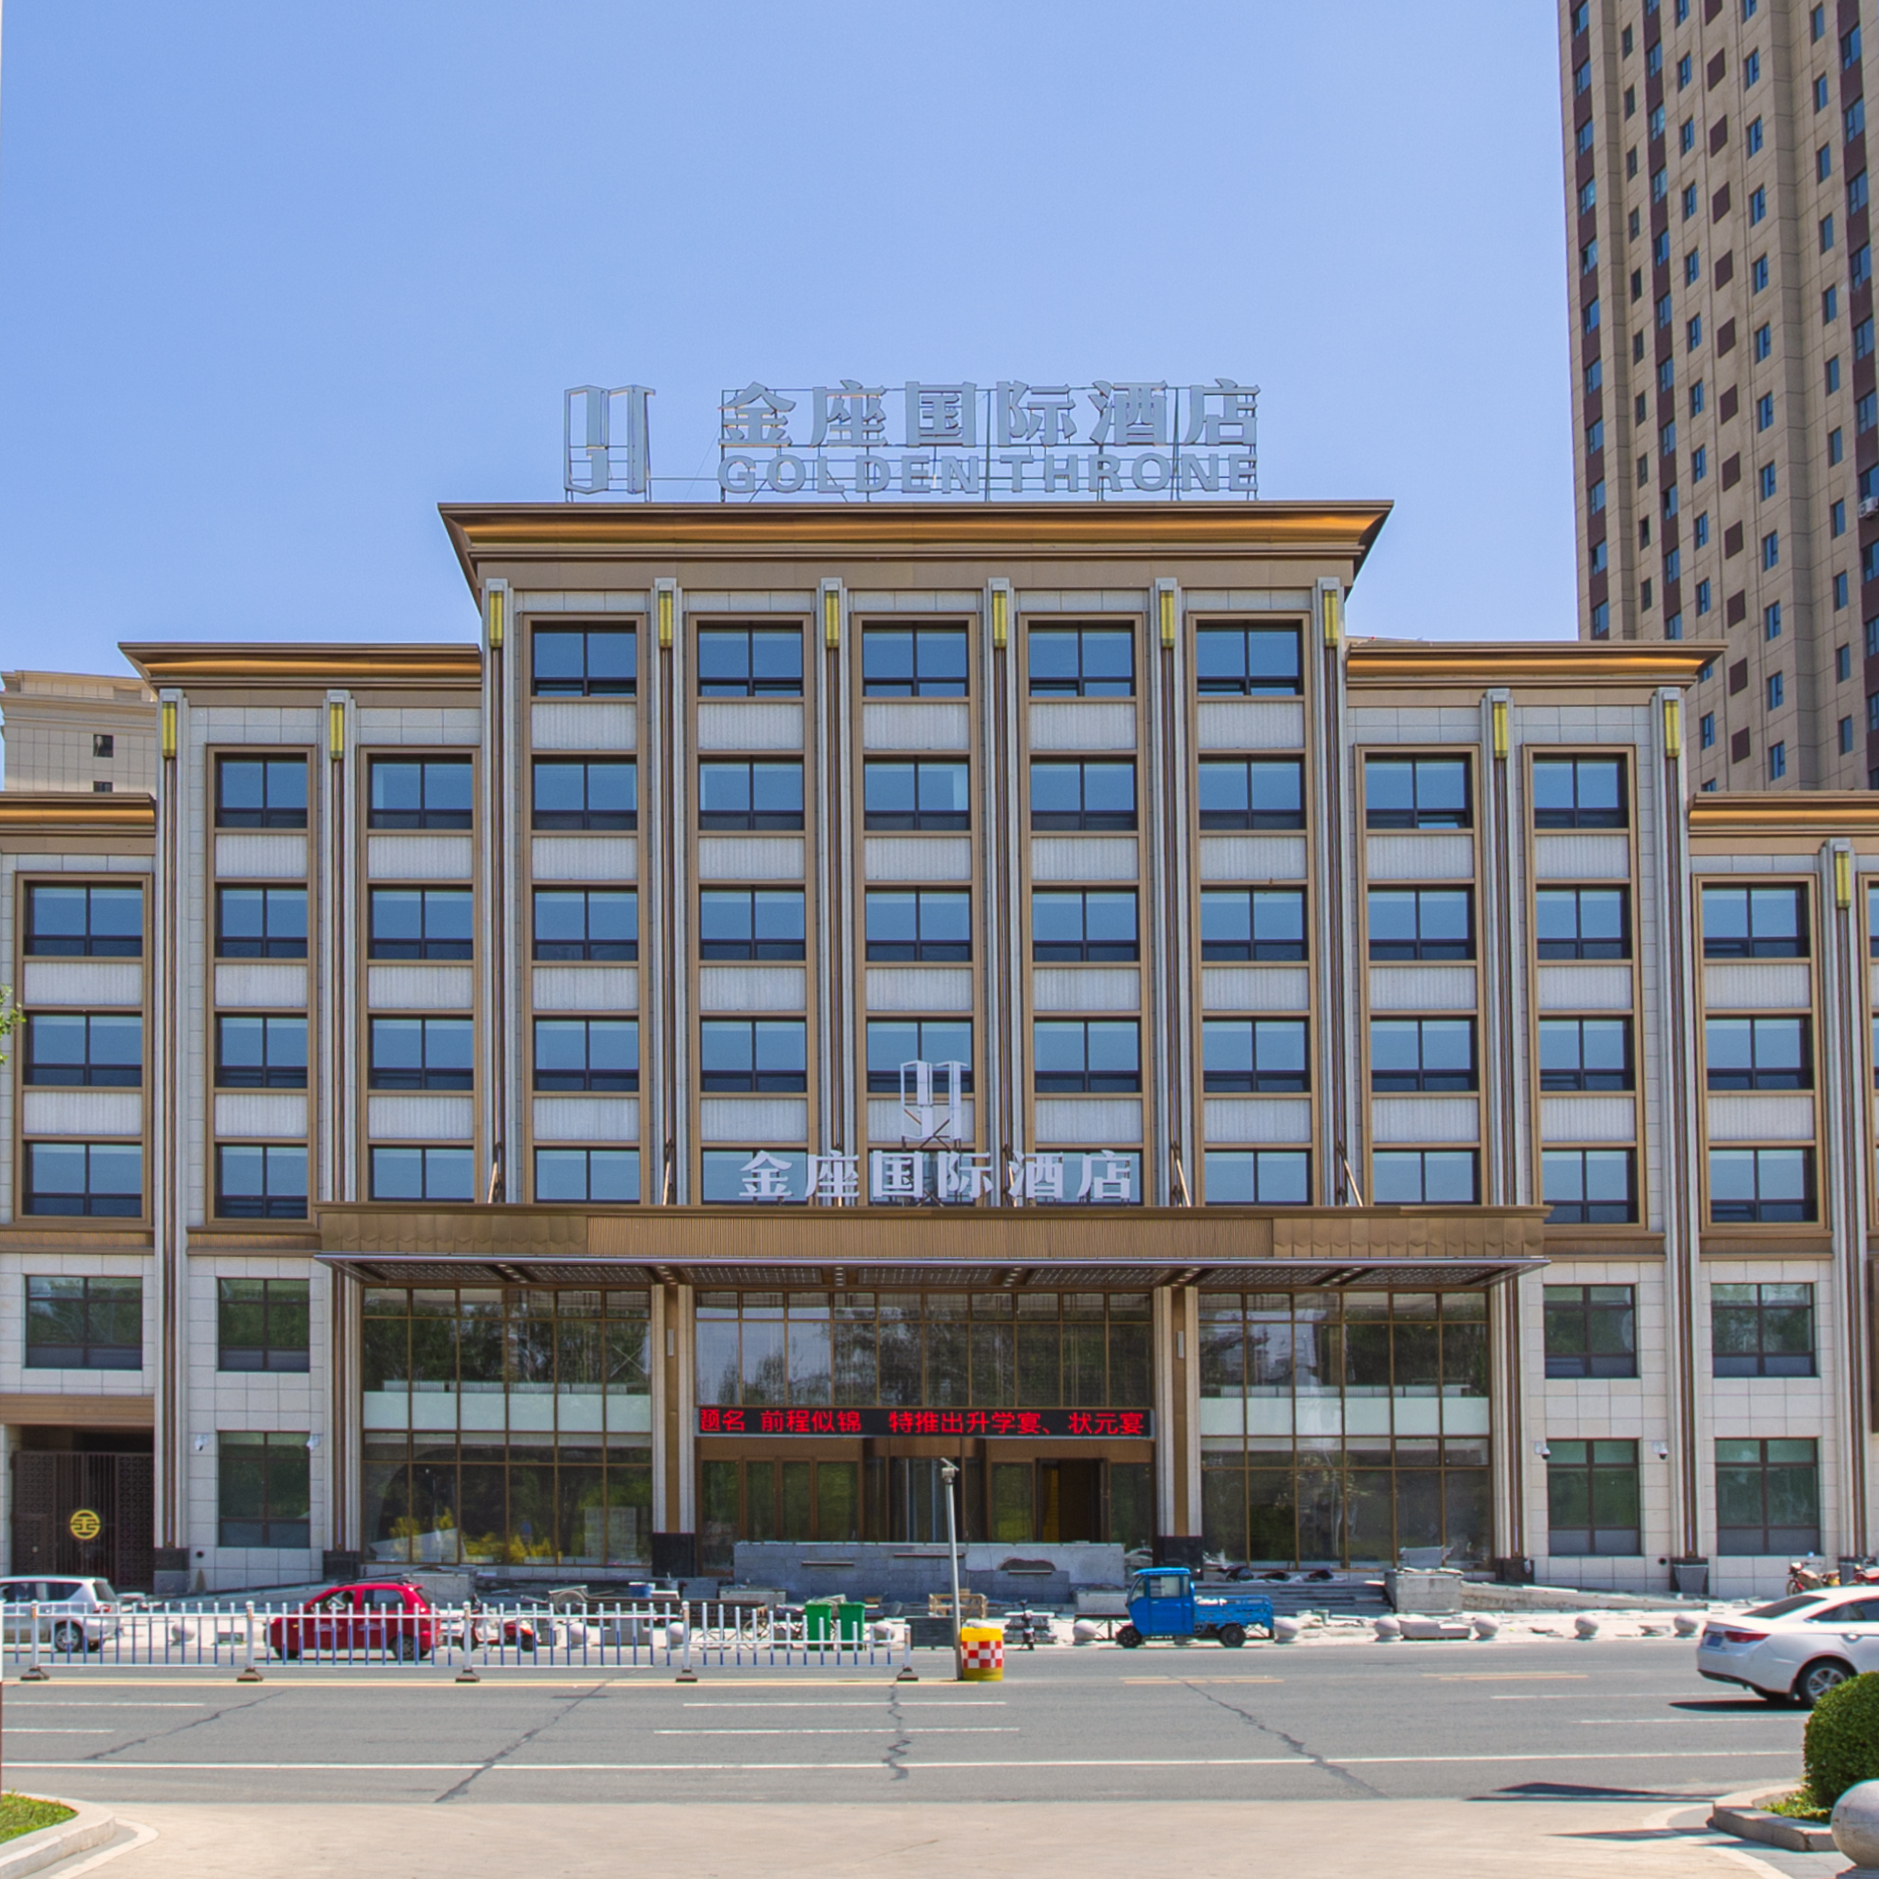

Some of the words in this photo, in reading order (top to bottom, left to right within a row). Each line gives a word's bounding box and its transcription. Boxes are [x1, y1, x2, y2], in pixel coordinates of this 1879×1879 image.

[718, 378, 1260, 448] 金座国际酒店
[717, 454, 980, 494] GOLDEN
[999, 452, 1259, 493] THRONE
[738, 1149, 1133, 1199] 金座国际酒店
[700, 1408, 745, 1431] 题名
[762, 1409, 862, 1432] 前程似锦
